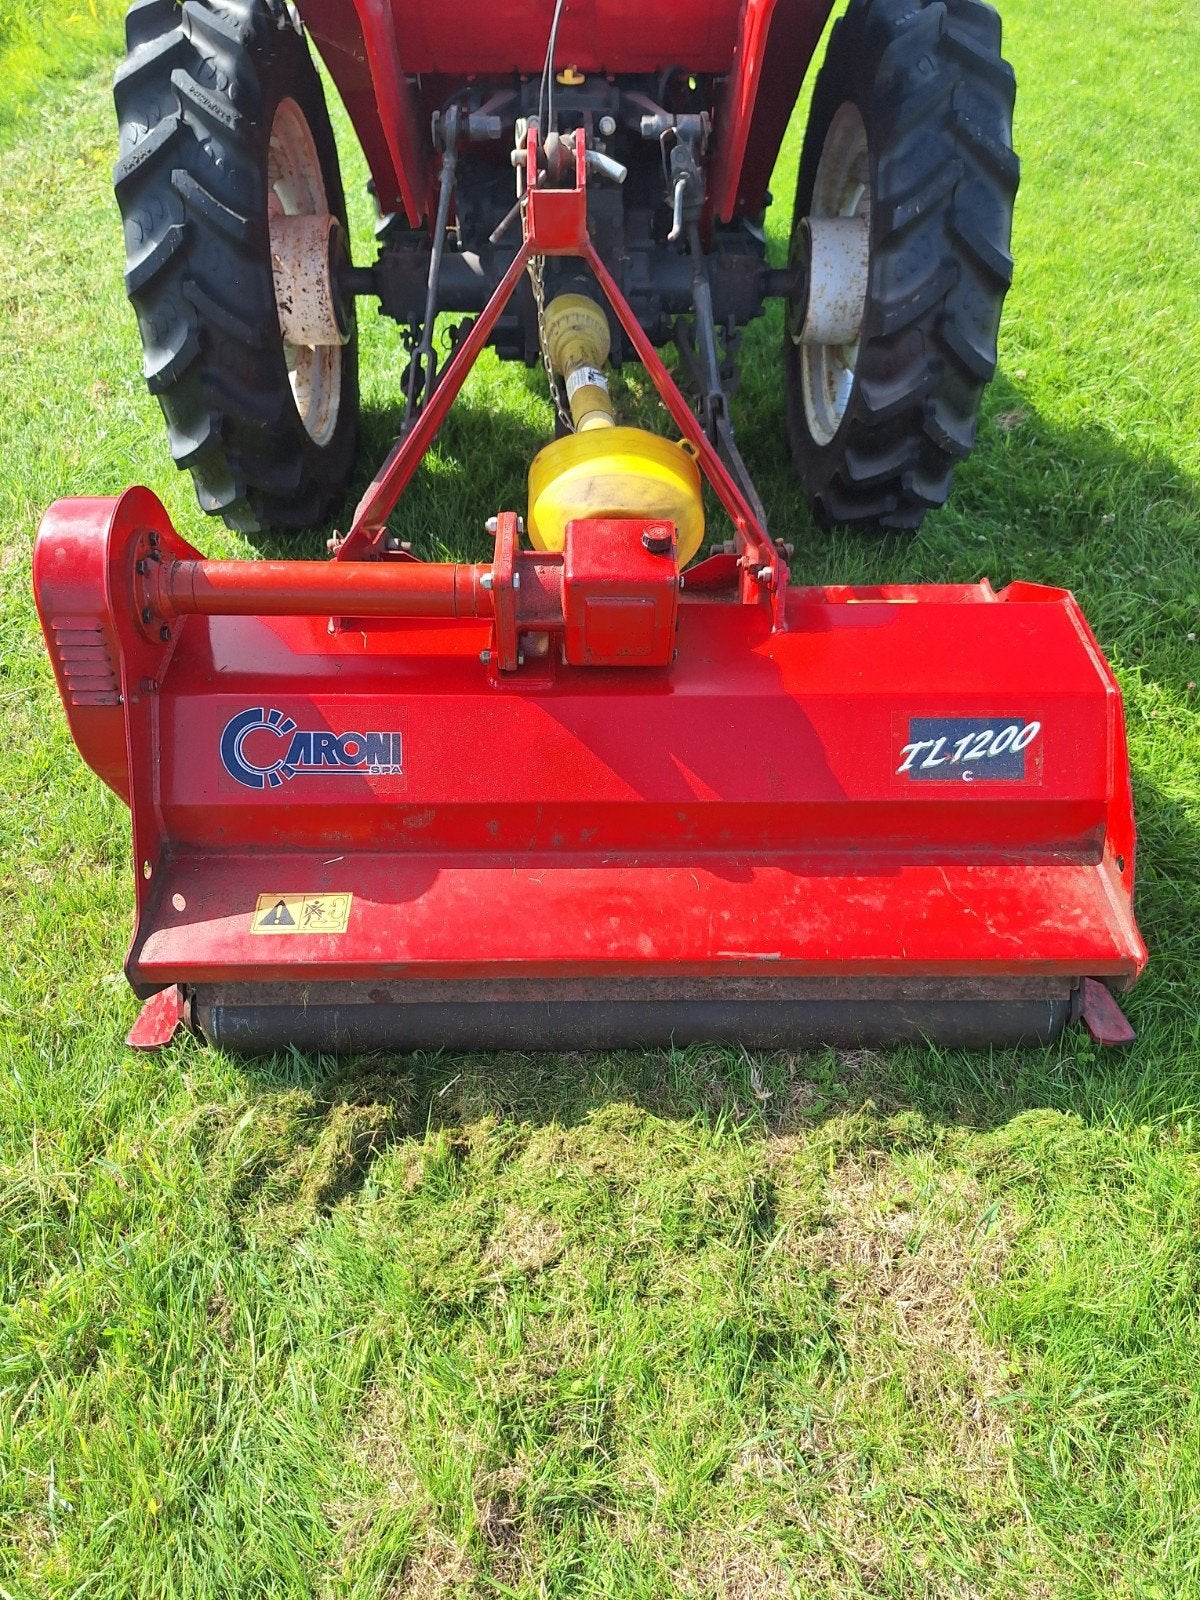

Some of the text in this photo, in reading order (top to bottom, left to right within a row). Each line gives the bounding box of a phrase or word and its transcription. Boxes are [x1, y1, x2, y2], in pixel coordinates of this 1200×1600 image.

[220, 707, 402, 789] CARONI
[950, 721, 1041, 765] 1200
[369, 765, 402, 775] SPA
